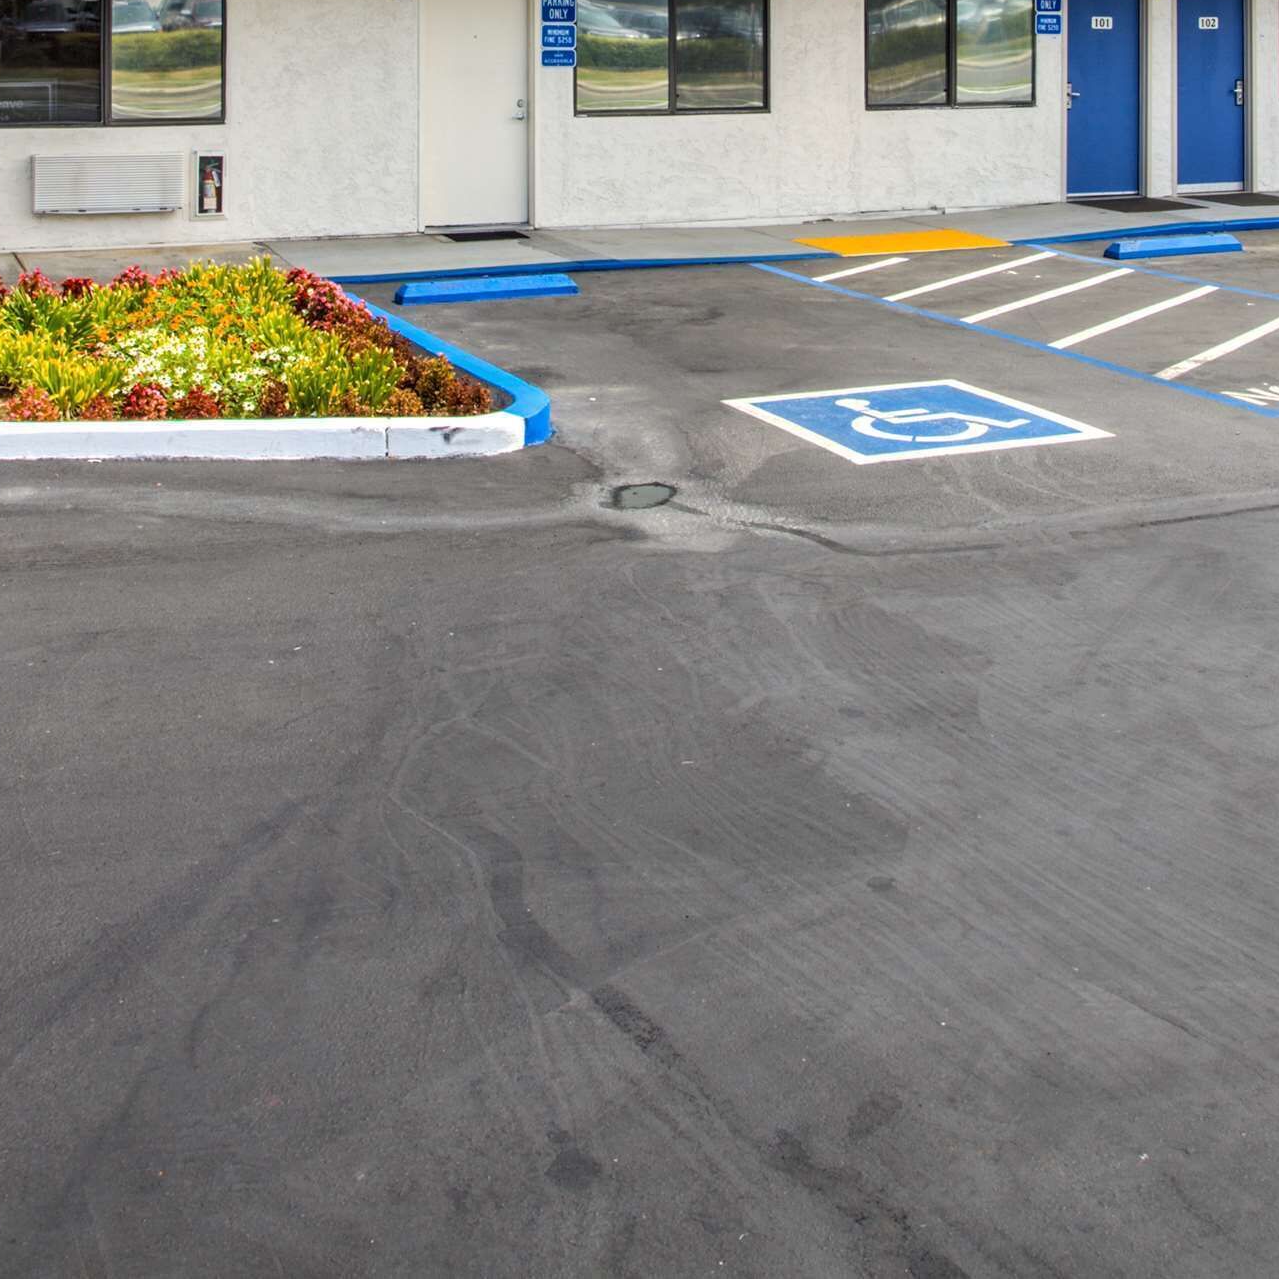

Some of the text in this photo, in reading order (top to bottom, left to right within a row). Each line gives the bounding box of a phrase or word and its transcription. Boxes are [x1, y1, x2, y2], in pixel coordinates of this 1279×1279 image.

[1040, 0, 1057, 10] ONLY
[548, 8, 569, 19] ONLY
[1094, 18, 1110, 27] 101
[1200, 18, 1216, 27] 102
[544, 36, 557, 44] FINE
